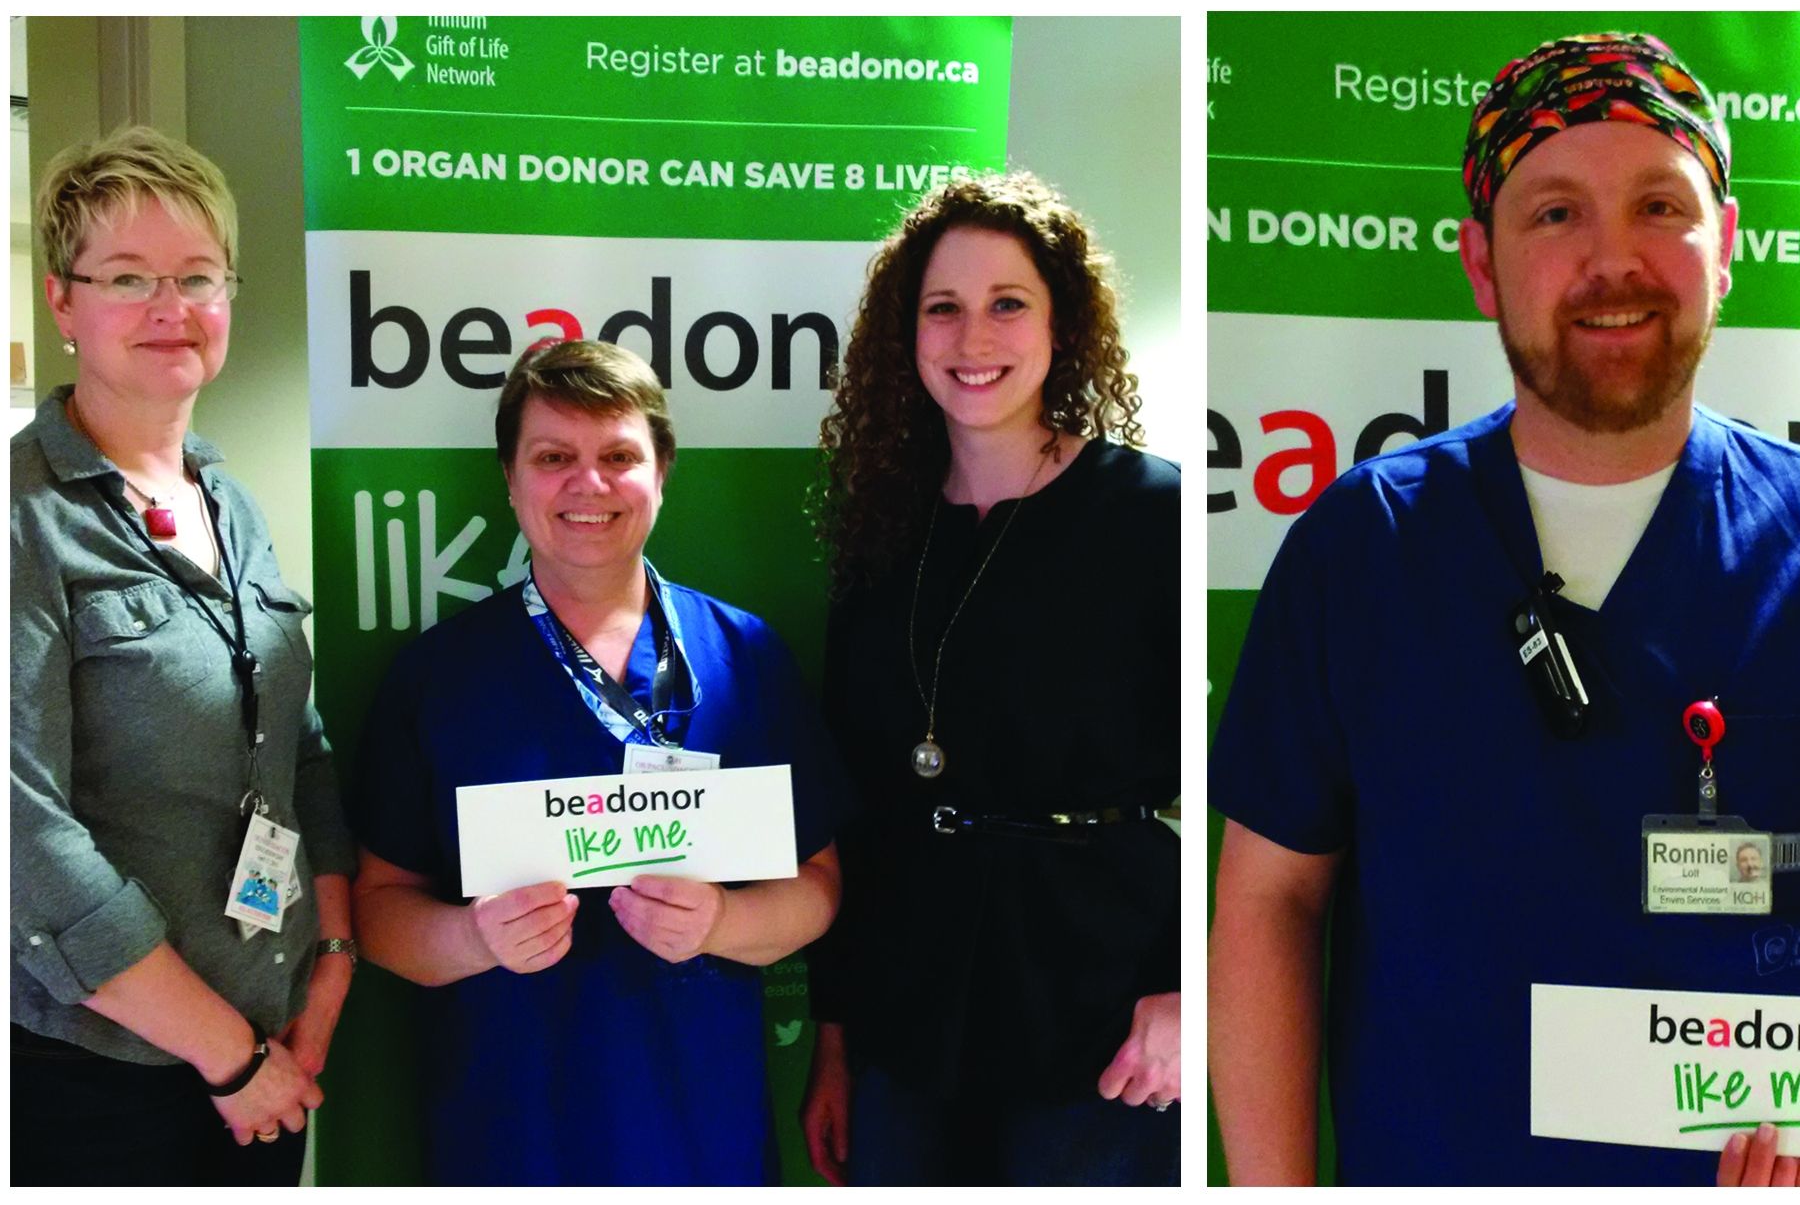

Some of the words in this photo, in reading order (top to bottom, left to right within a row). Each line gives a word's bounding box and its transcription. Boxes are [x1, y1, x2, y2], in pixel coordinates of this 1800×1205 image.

[426, 34, 455, 56] Gift
[459, 36, 477, 57] of
[480, 37, 509, 59] Life
[586, 41, 724, 77] Register
[734, 50, 767, 77] at
[776, 49, 980, 84] beadonor.ca
[427, 62, 496, 87] Network
[345, 148, 361, 176] 1
[373, 149, 508, 180] ORGAN
[518, 154, 650, 186] DONOR
[660, 160, 735, 188] CAN
[744, 161, 835, 190] SAVE
[844, 162, 866, 190] 8
[1248, 209, 1418, 251] DONOR
[544, 784, 705, 818] beadonor
[565, 827, 621, 862] like
[634, 820, 693, 852] me.
[1652, 842, 1729, 864] Ronnie
[1674, 1063, 1751, 1113] like
